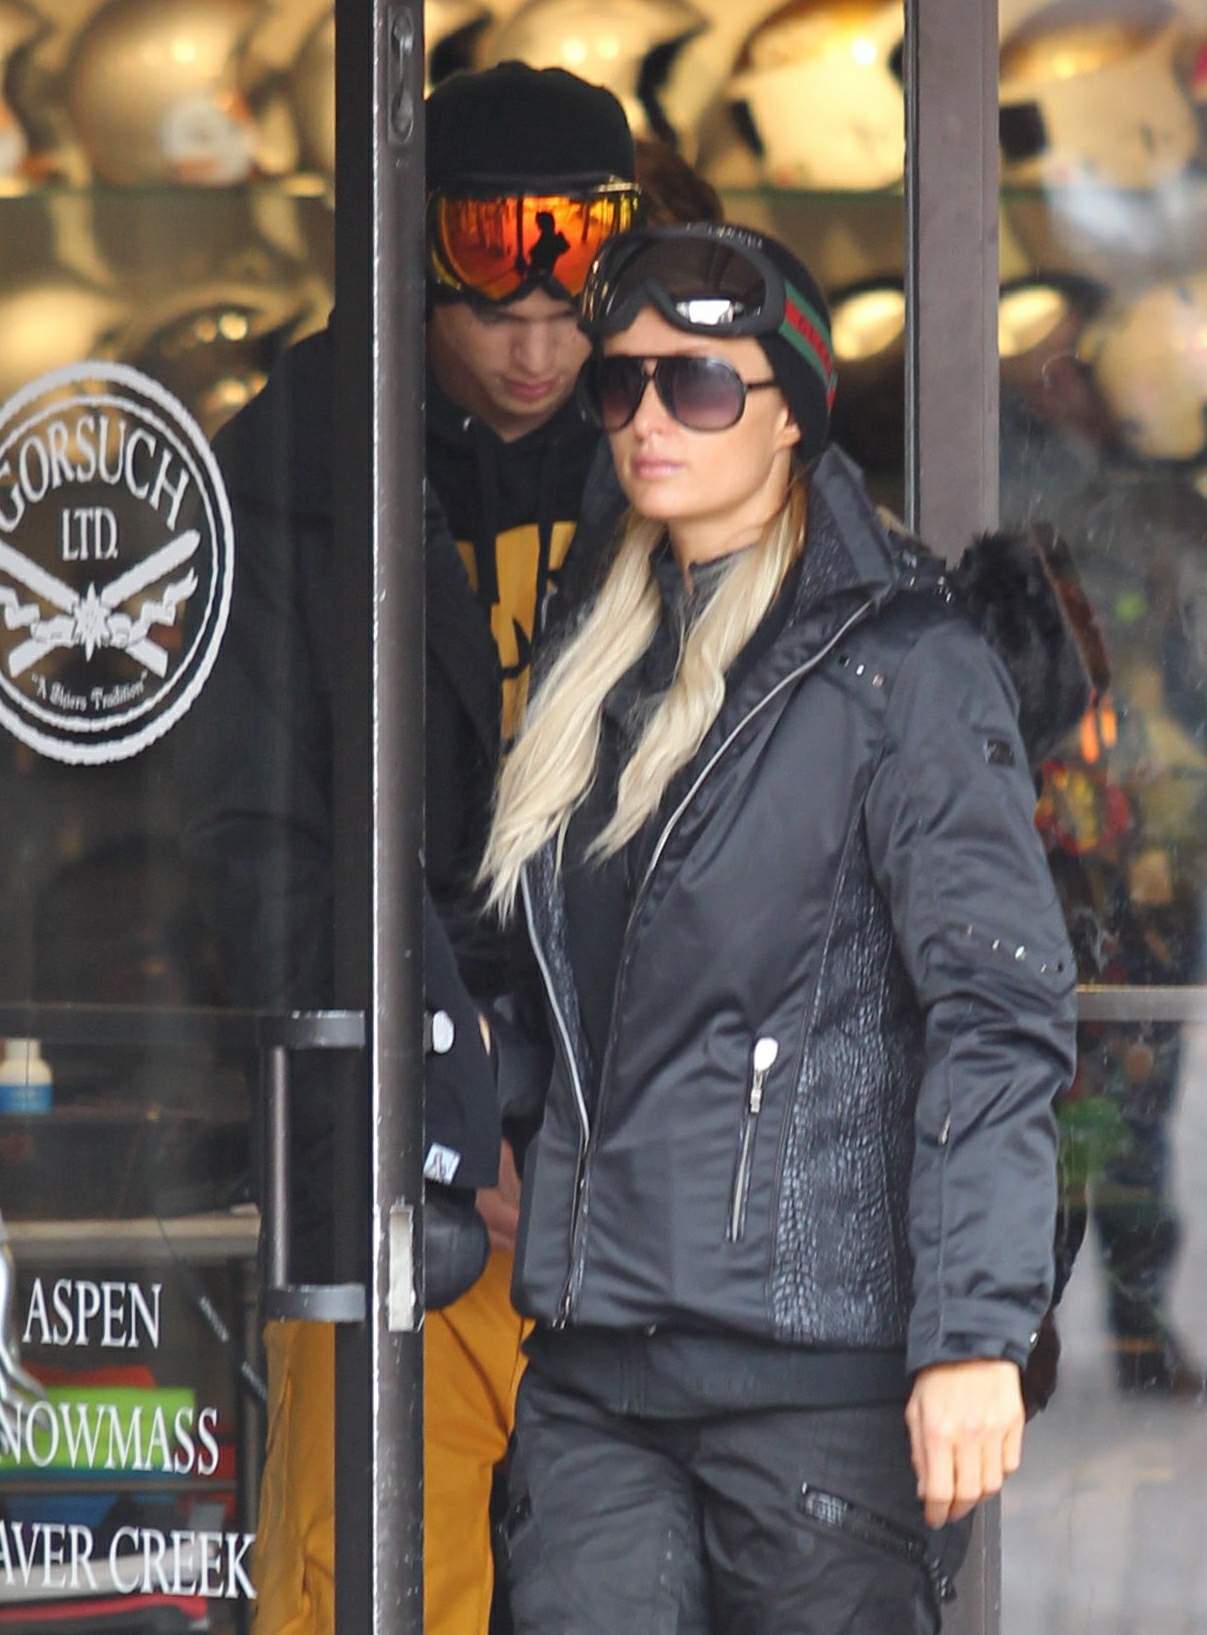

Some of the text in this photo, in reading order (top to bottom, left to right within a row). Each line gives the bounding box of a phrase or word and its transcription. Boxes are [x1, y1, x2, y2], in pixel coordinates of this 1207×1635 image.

[0, 415, 190, 533] GORSUCH
[62, 507, 119, 561] LTD.
[22, 1278, 162, 1349] ASPEN
[0, 1400, 219, 1476] NOWMASS
[109, 1526, 257, 1599] CREEK
